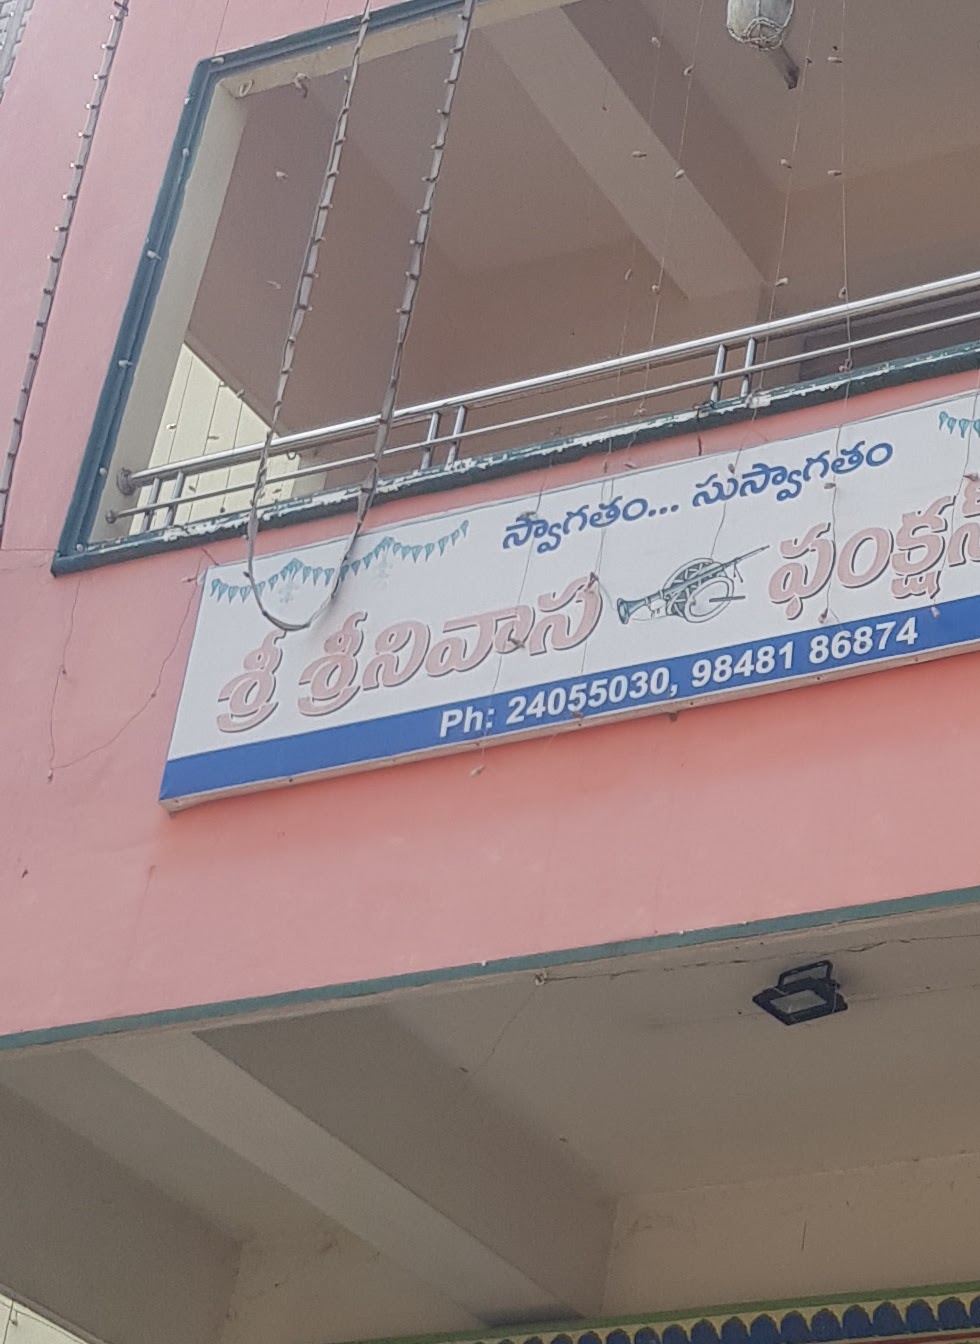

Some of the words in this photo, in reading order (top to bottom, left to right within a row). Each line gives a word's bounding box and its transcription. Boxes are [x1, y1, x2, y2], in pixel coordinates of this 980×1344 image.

[691, 440, 893, 502] సుస్వాగతం
[216, 628, 287, 733] శ్రీ
[298, 575, 602, 717] శ్రీనివాస
[440, 706, 495, 738] Ph:
[505, 665, 678, 725] 24055030,
[691, 641, 794, 689] 98481
[808, 617, 918, 665] 86874
